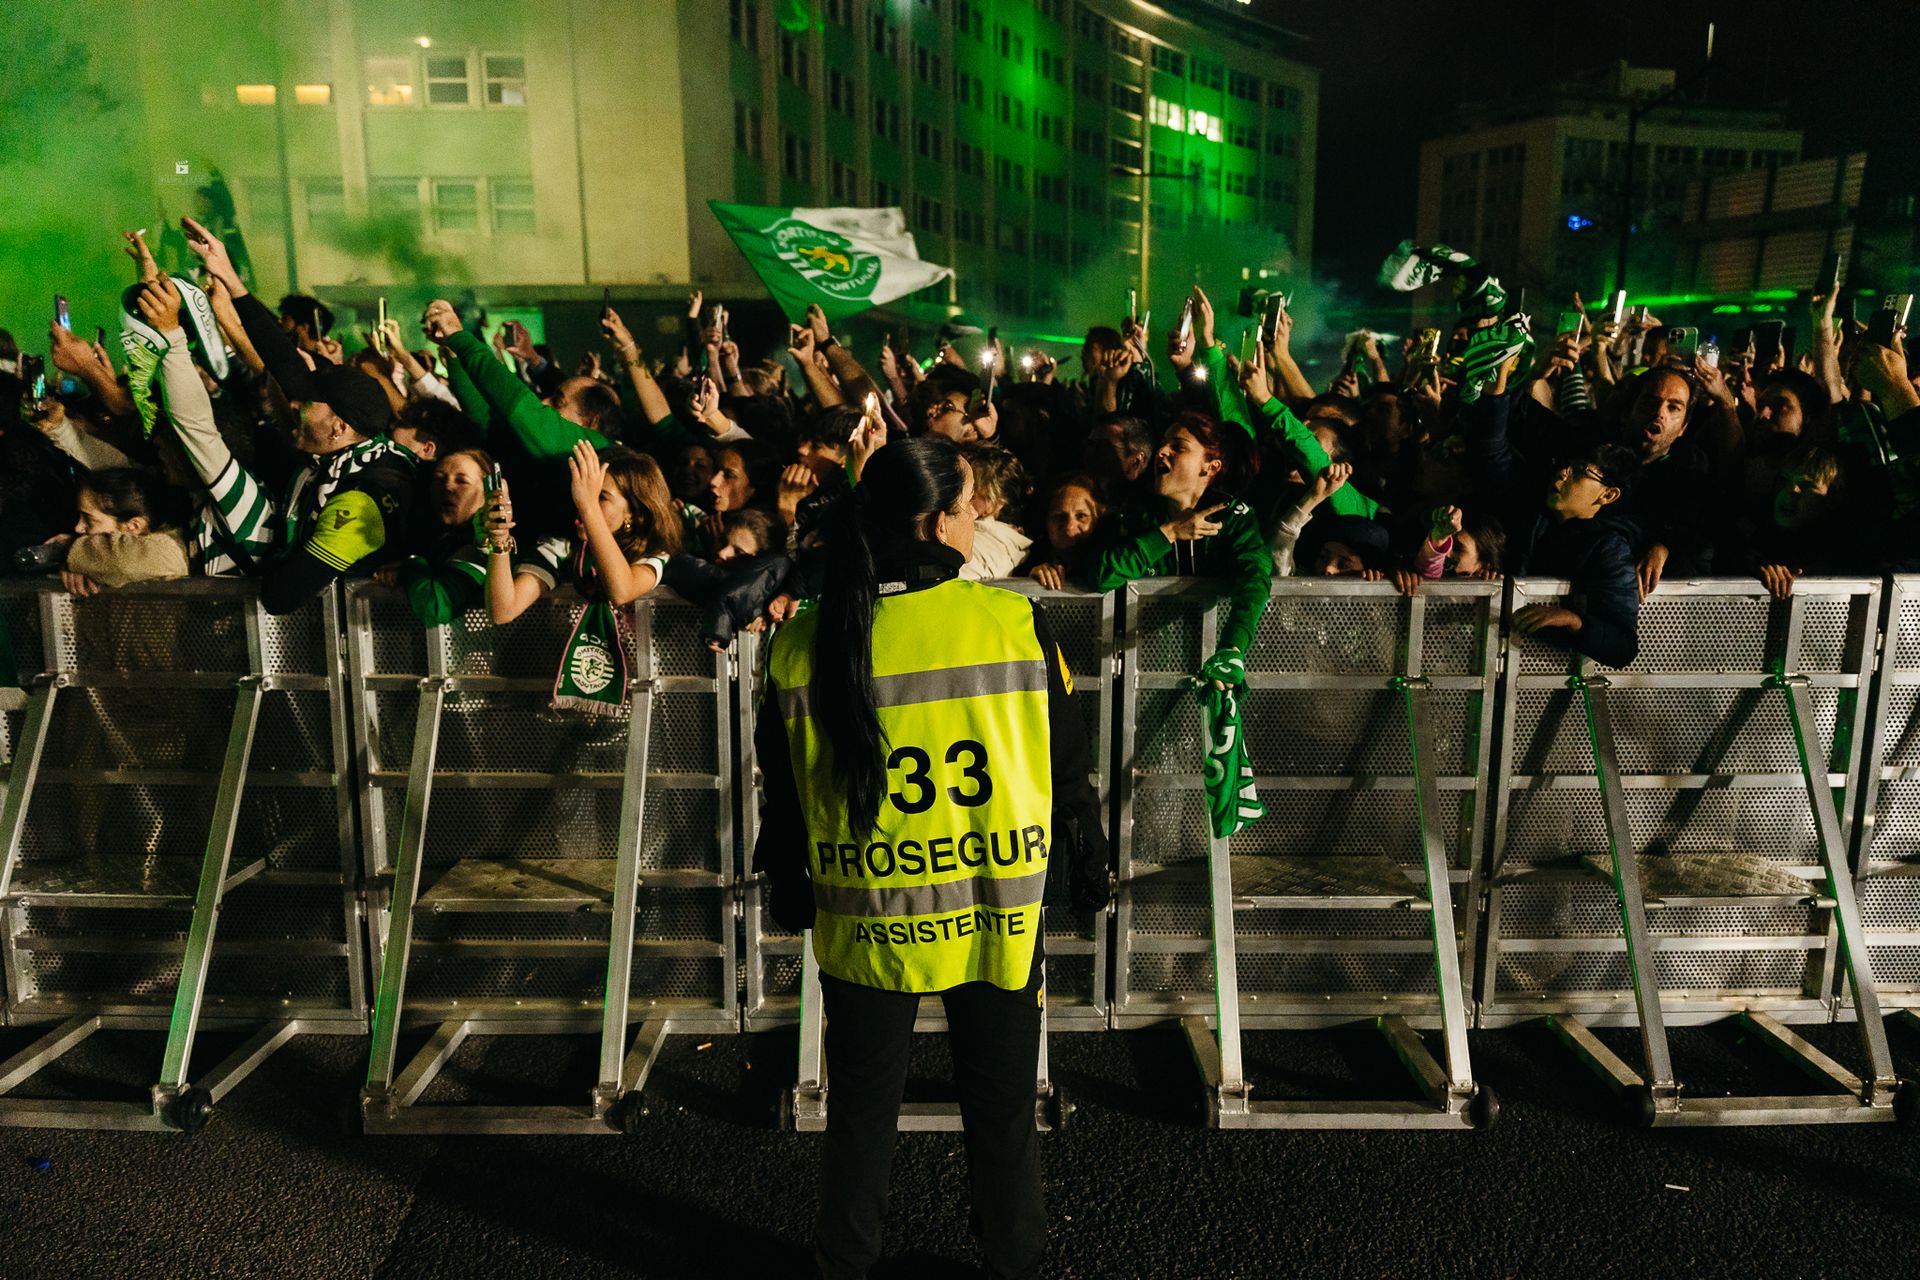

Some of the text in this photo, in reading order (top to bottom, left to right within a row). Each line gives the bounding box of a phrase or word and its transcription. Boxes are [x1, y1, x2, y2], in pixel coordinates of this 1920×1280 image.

[886, 739, 993, 815] 33
[816, 824, 1048, 879] PROSEGUR
[855, 908, 1025, 945] ASSISTENTE
